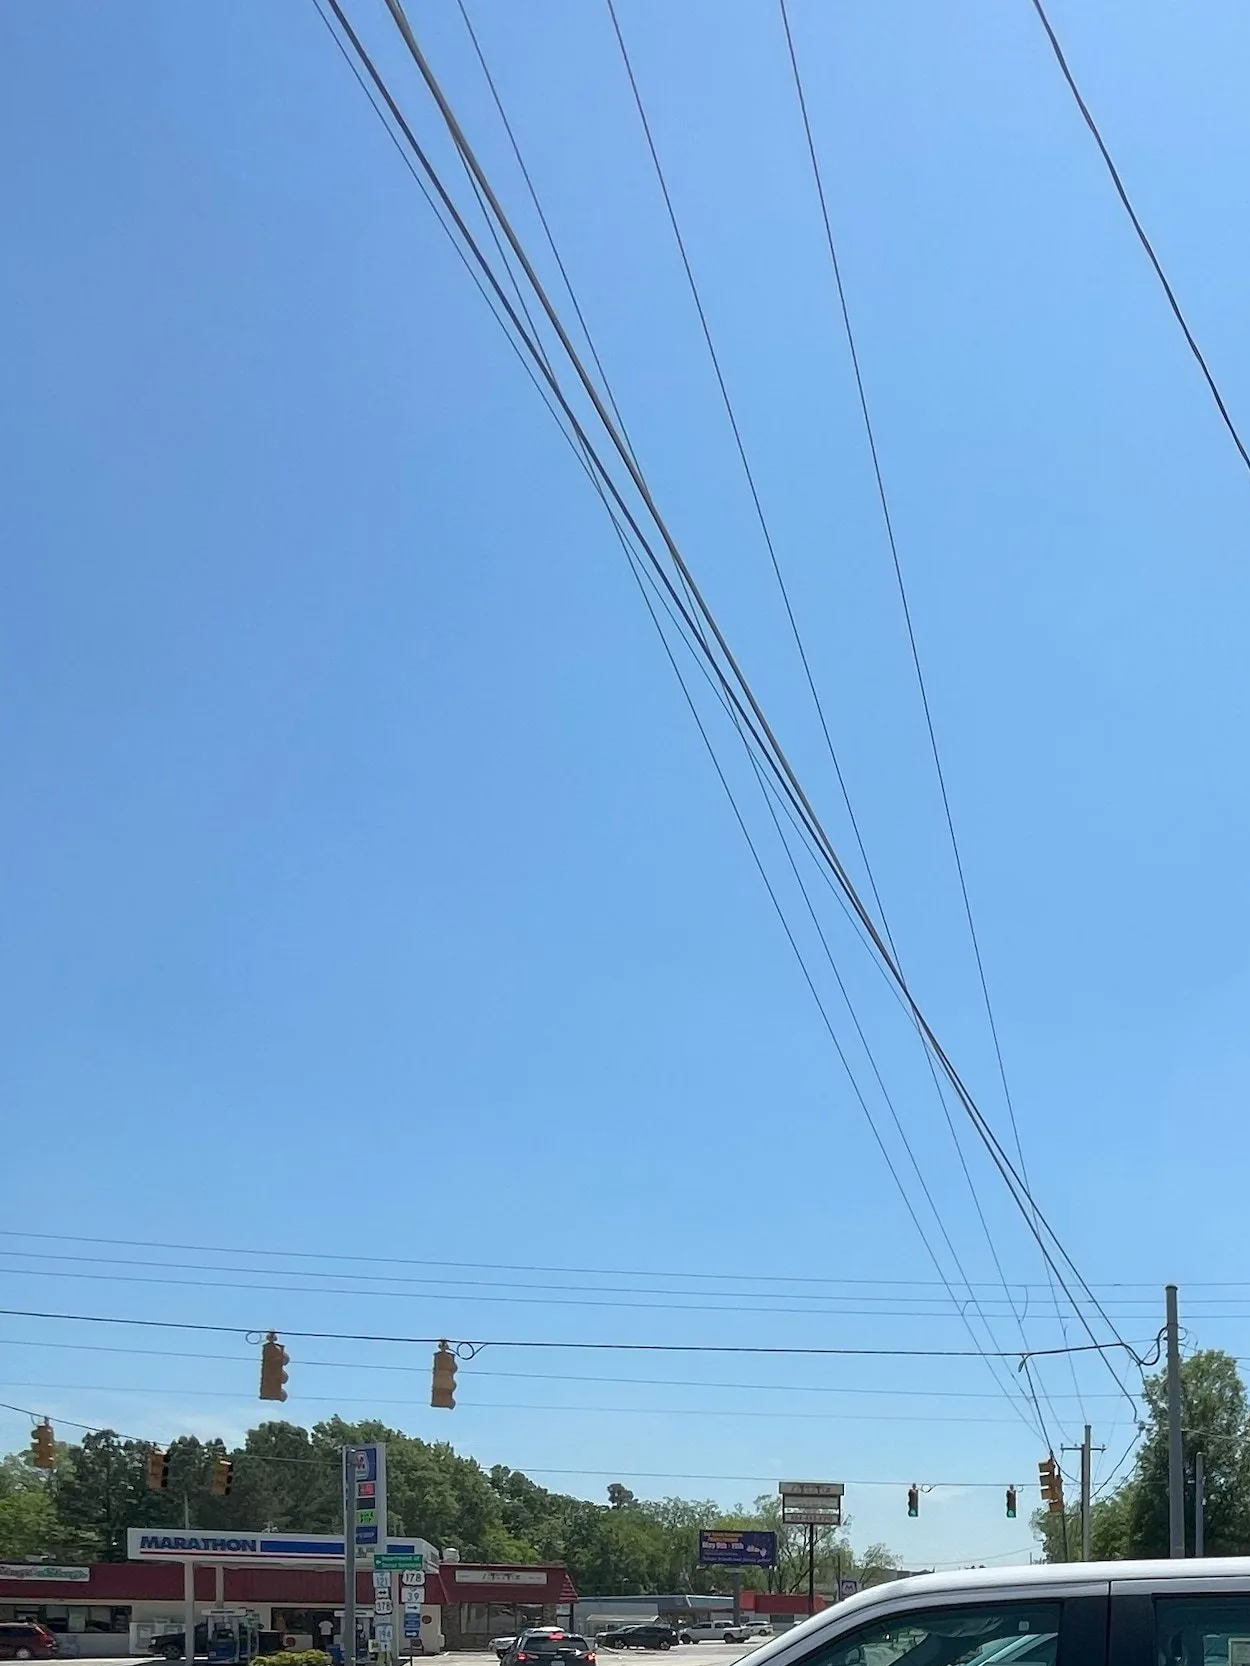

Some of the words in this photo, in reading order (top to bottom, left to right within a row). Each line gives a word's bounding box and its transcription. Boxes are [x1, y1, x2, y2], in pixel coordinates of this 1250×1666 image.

[140, 1536, 257, 1552] MARATHON
[405, 1573, 421, 1582] 178
[407, 1592, 419, 1602] 39
[377, 1601, 391, 1611] 378
